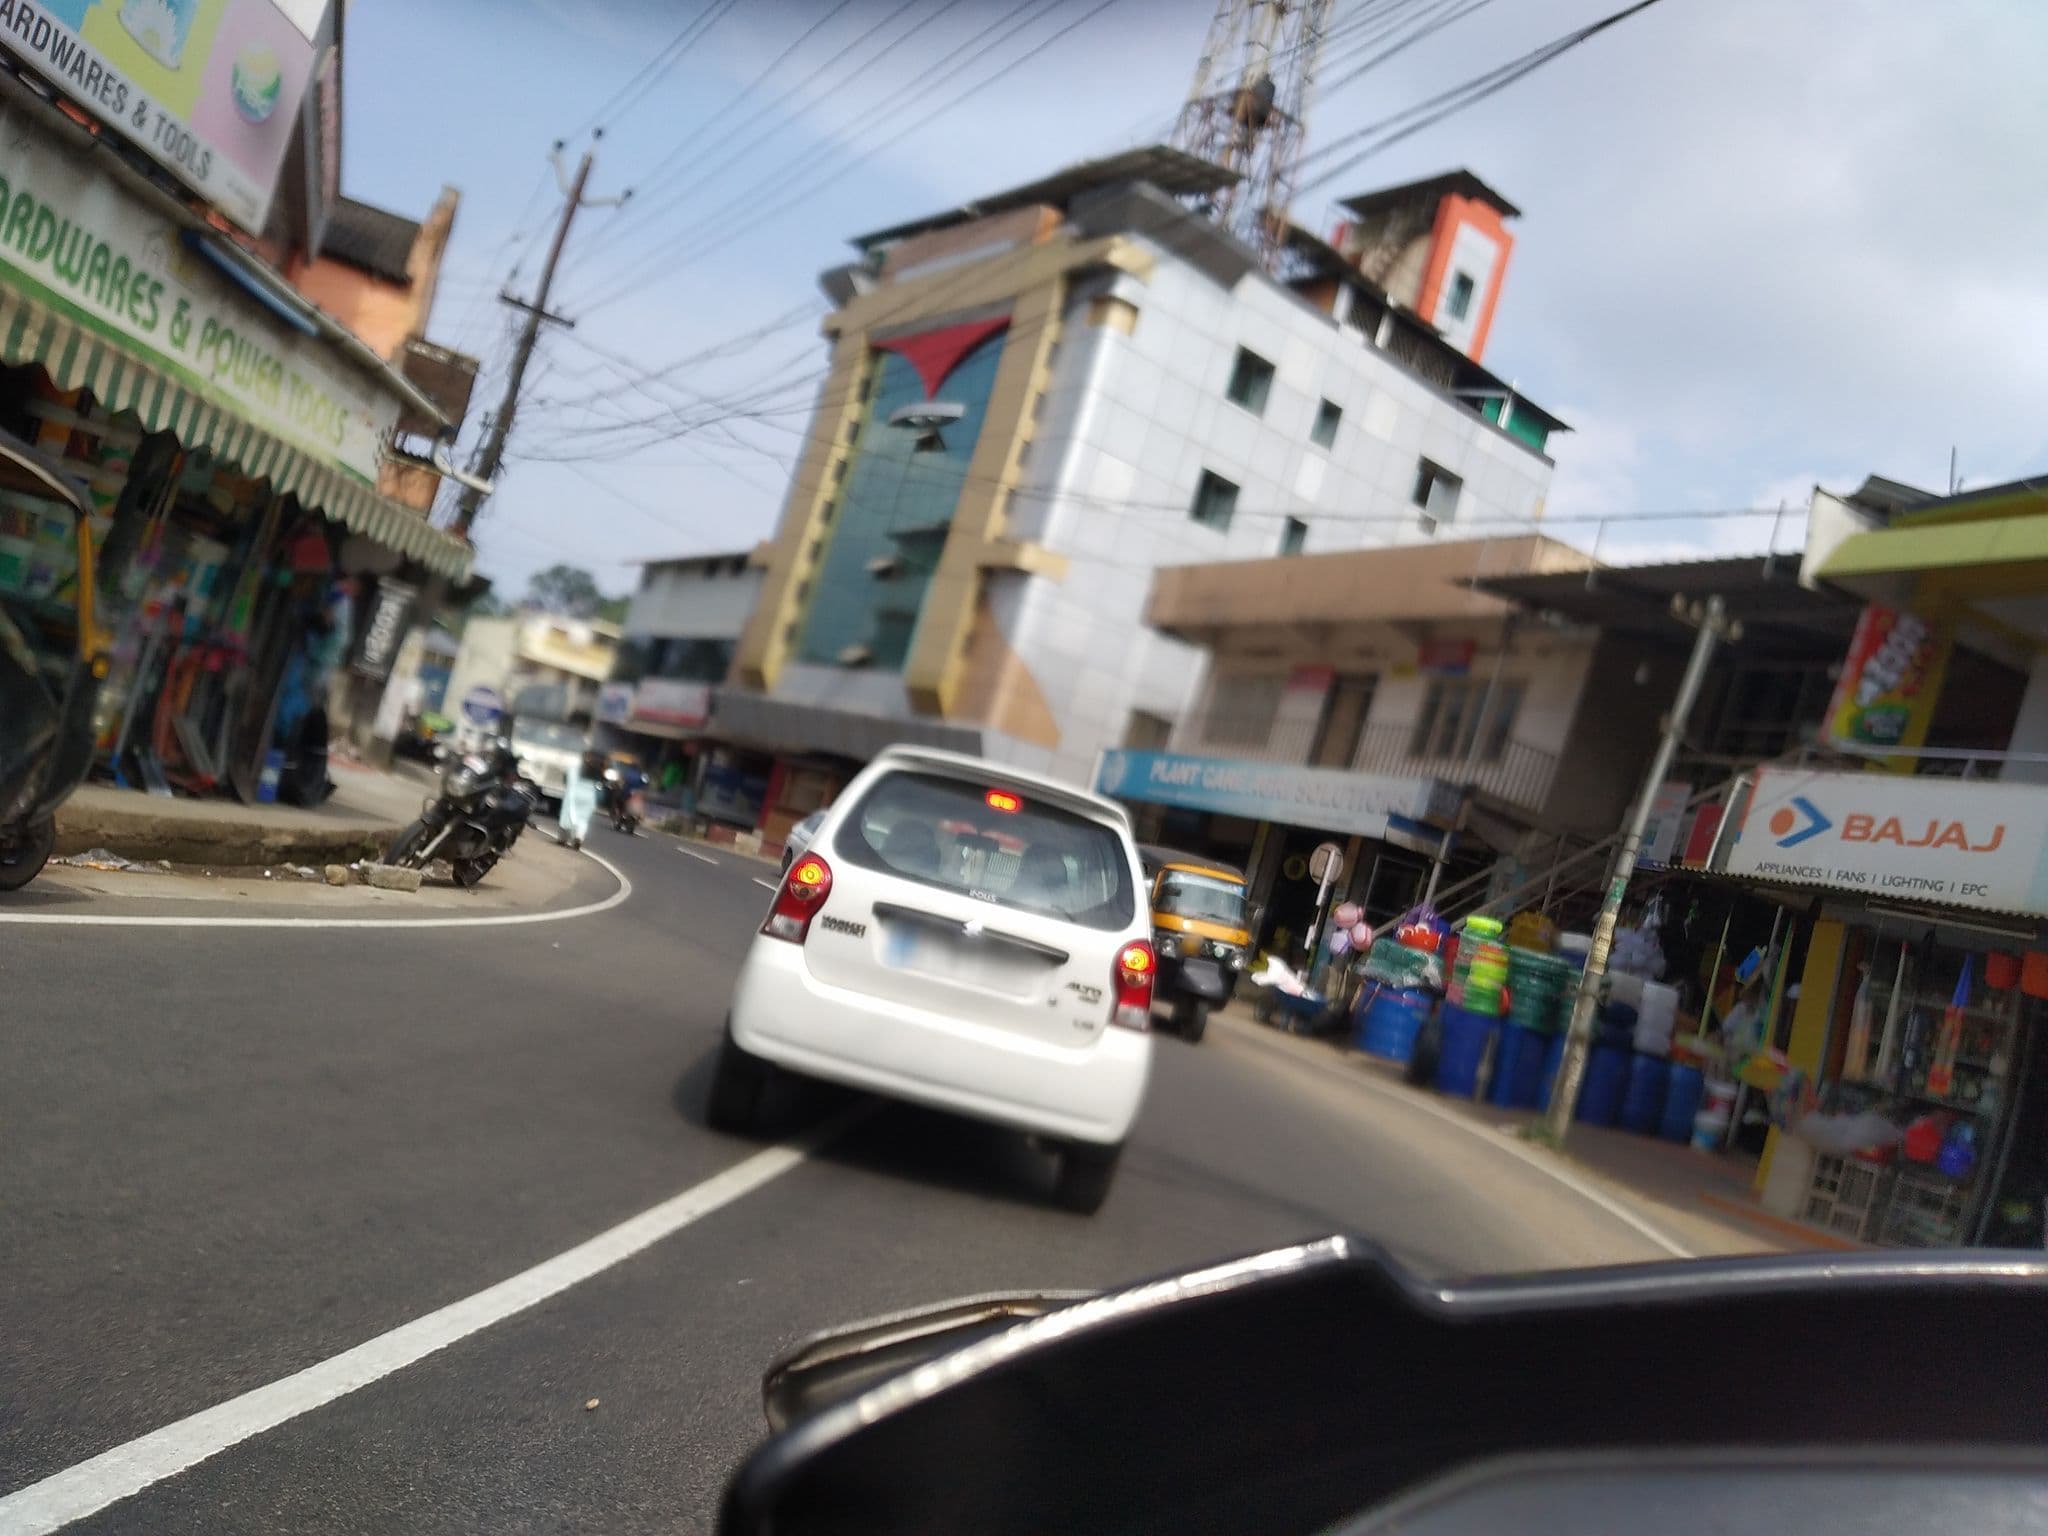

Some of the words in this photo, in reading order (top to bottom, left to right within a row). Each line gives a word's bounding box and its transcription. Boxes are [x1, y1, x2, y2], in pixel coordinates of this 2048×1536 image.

[0, 0, 129, 115] ARDWARES
[131, 99, 147, 129] &
[152, 112, 213, 181] TOOLS
[169, 297, 192, 352] &
[196, 317, 284, 409] POWER
[287, 371, 349, 447] TOOLS
[1150, 760, 1201, 785] PLANT
[1840, 813, 2007, 853] BAJAJ
[1755, 861, 1823, 879] APPLIANCES
[1836, 870, 1867, 885] FANS
[1881, 875, 1945, 893] LIGHTING
[1960, 883, 1989, 898] EPC
